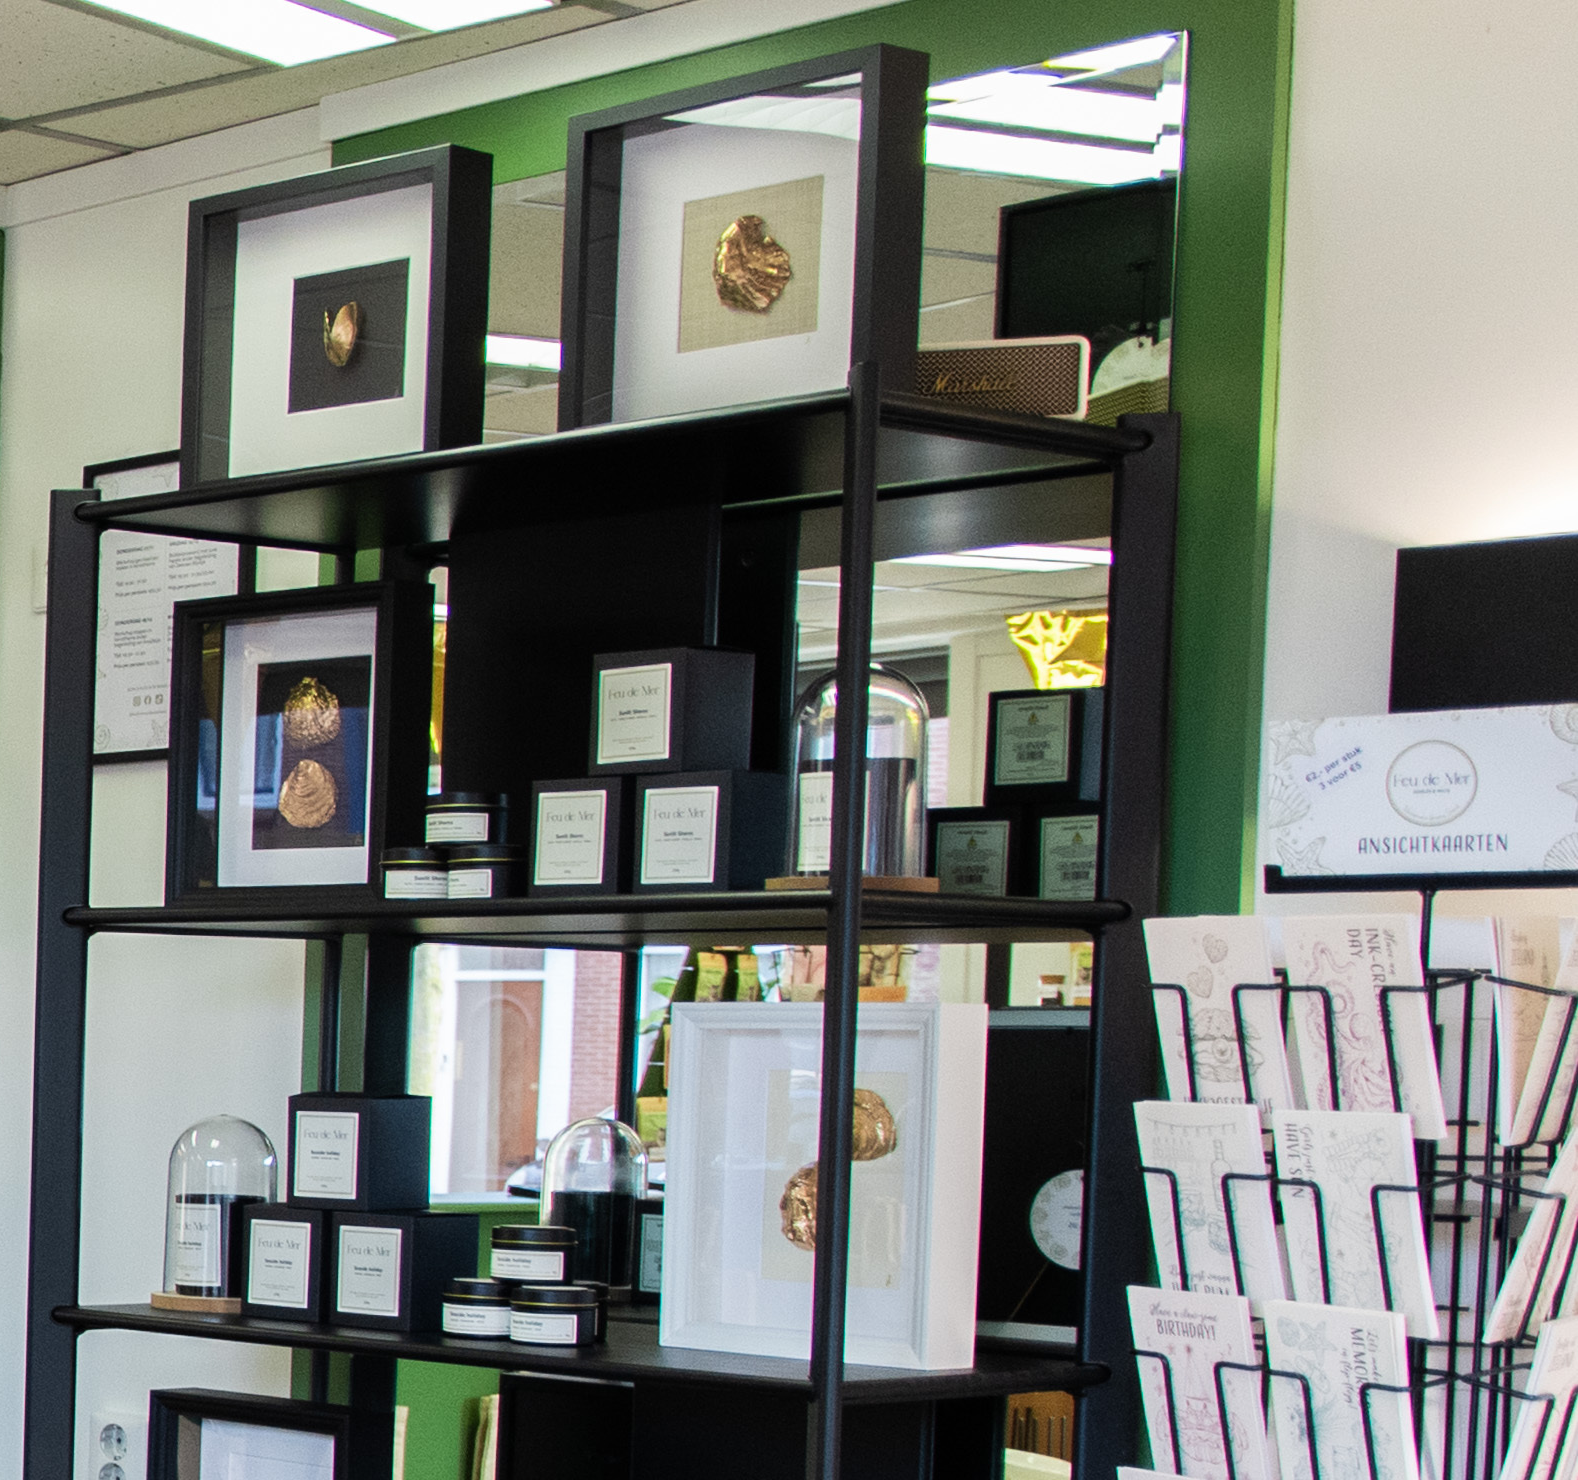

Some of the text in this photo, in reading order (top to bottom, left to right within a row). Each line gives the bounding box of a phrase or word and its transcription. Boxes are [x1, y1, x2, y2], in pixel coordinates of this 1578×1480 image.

[1324, 758, 1341, 776] per
[1342, 747, 1363, 763] stuk
[1327, 769, 1349, 786] voor
[1394, 772, 1469, 788] Feu de Mer
[1358, 833, 1509, 855] ANSICHTKAARTEN
[1346, 929, 1364, 959] DAY
[1285, 1123, 1305, 1198] HAVE SN
[1156, 1319, 1216, 1340] BIRTHDAY!
